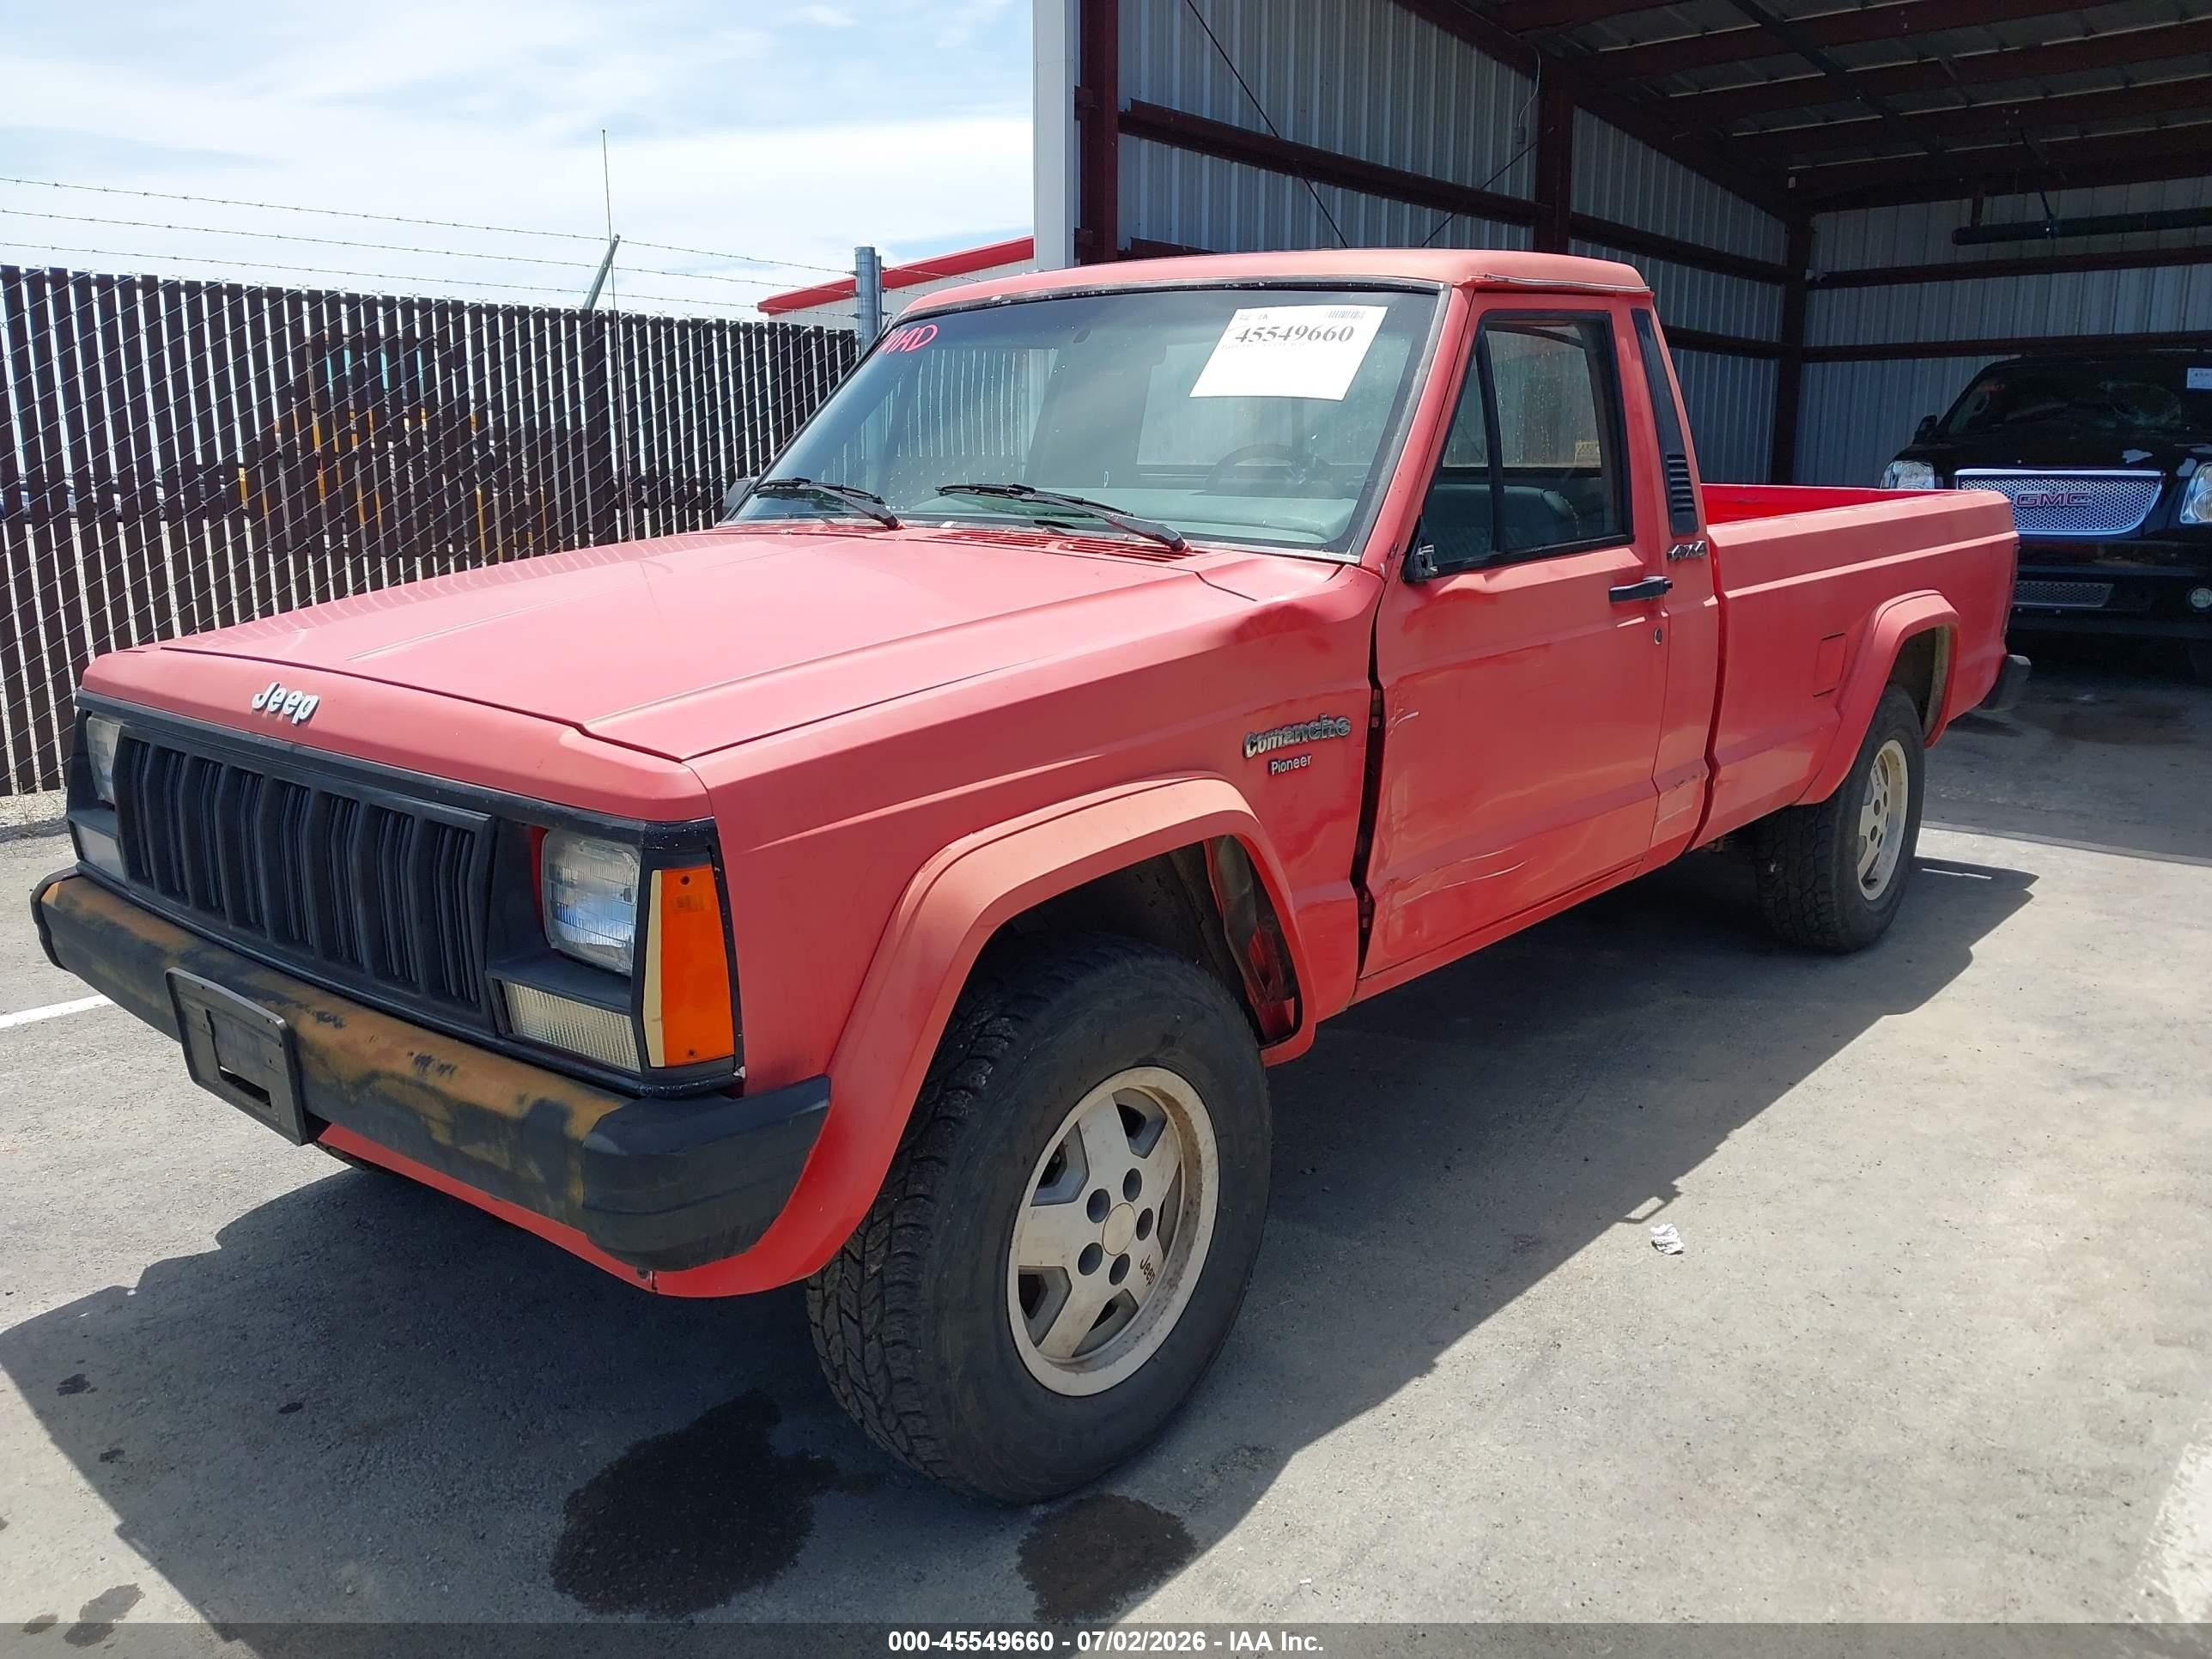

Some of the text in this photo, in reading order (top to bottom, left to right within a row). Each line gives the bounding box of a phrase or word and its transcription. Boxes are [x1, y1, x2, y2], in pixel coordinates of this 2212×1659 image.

[1235, 325, 1355, 343] 45549660
[2016, 493, 2089, 507] GMC
[252, 682, 320, 726] Jeep
[1243, 714, 1352, 757] Comanche
[1271, 756, 1312, 775] Pioneer
[1139, 1255, 1156, 1286] Jeep
